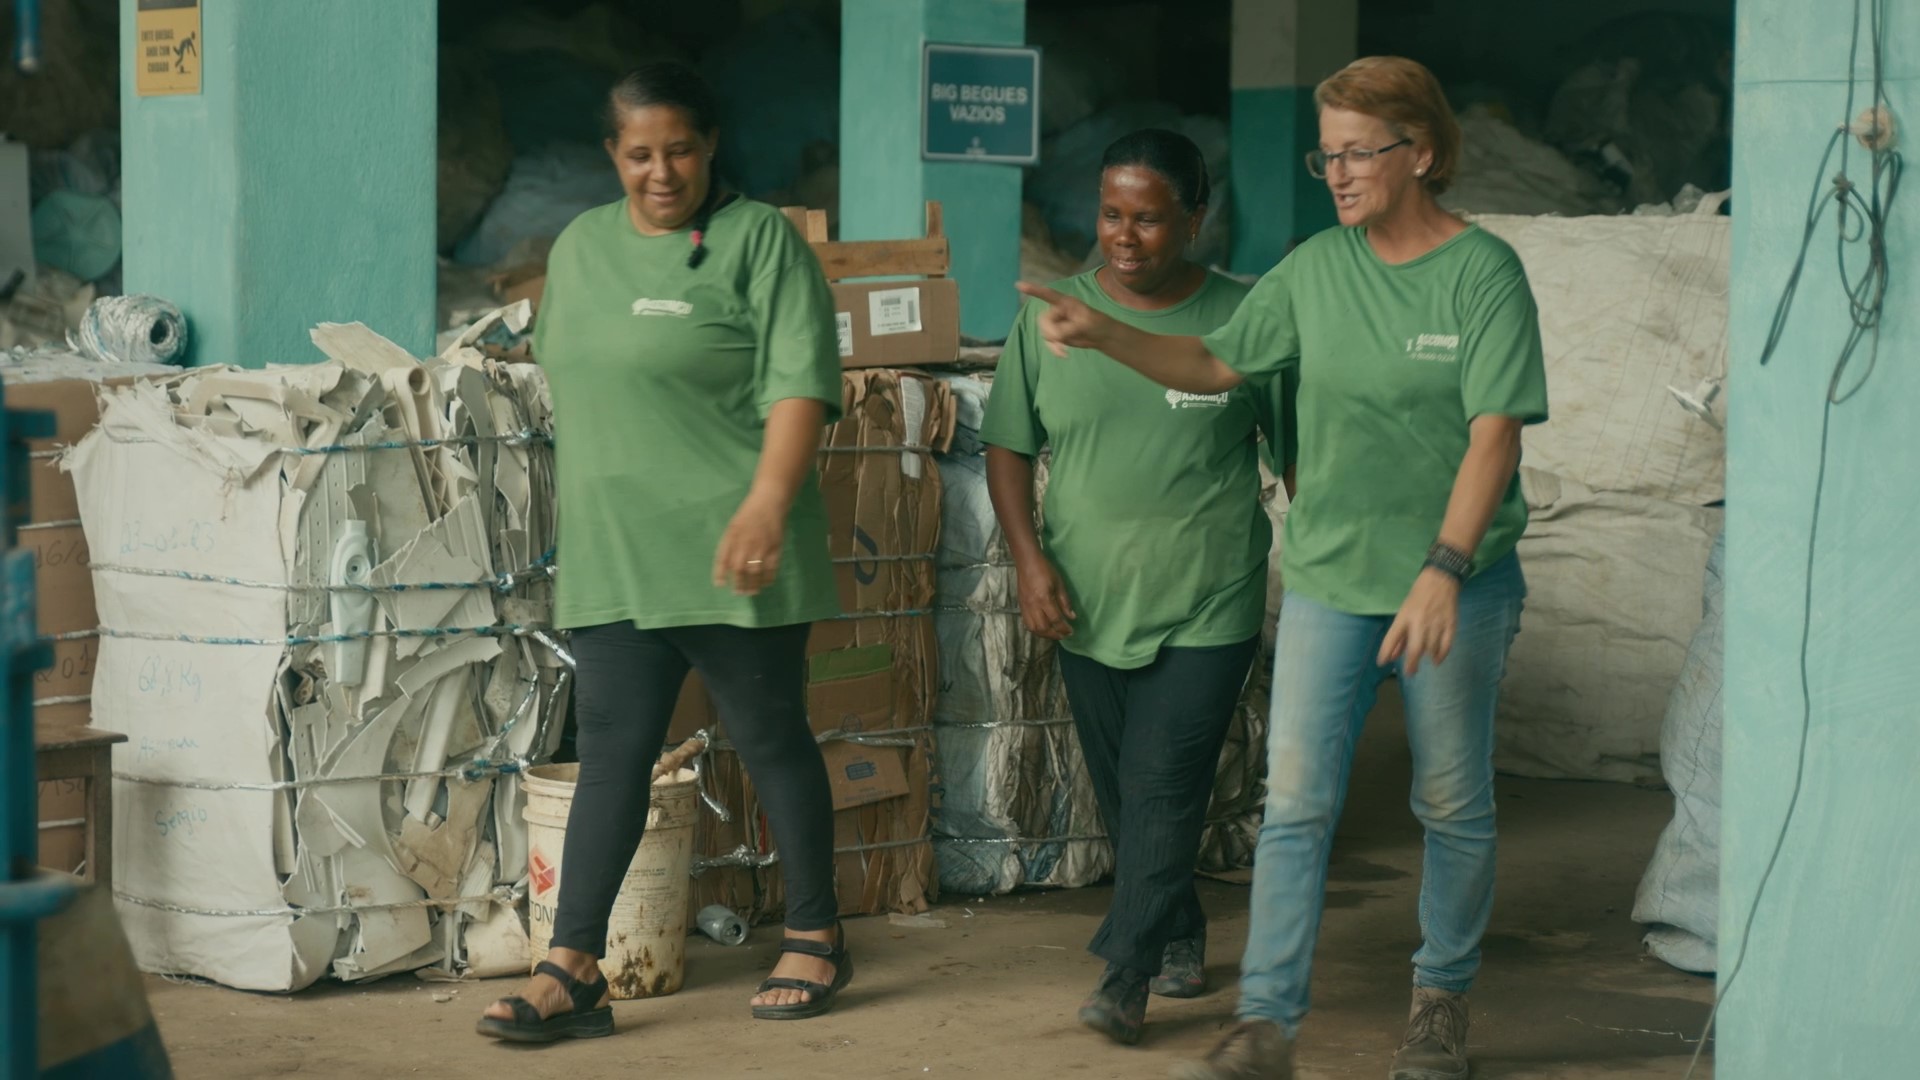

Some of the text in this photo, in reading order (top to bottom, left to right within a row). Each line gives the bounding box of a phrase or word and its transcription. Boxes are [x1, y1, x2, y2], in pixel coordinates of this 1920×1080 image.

[931, 83, 1028, 104] BIG BEGUES
[949, 104, 1006, 124] VAZIOS
